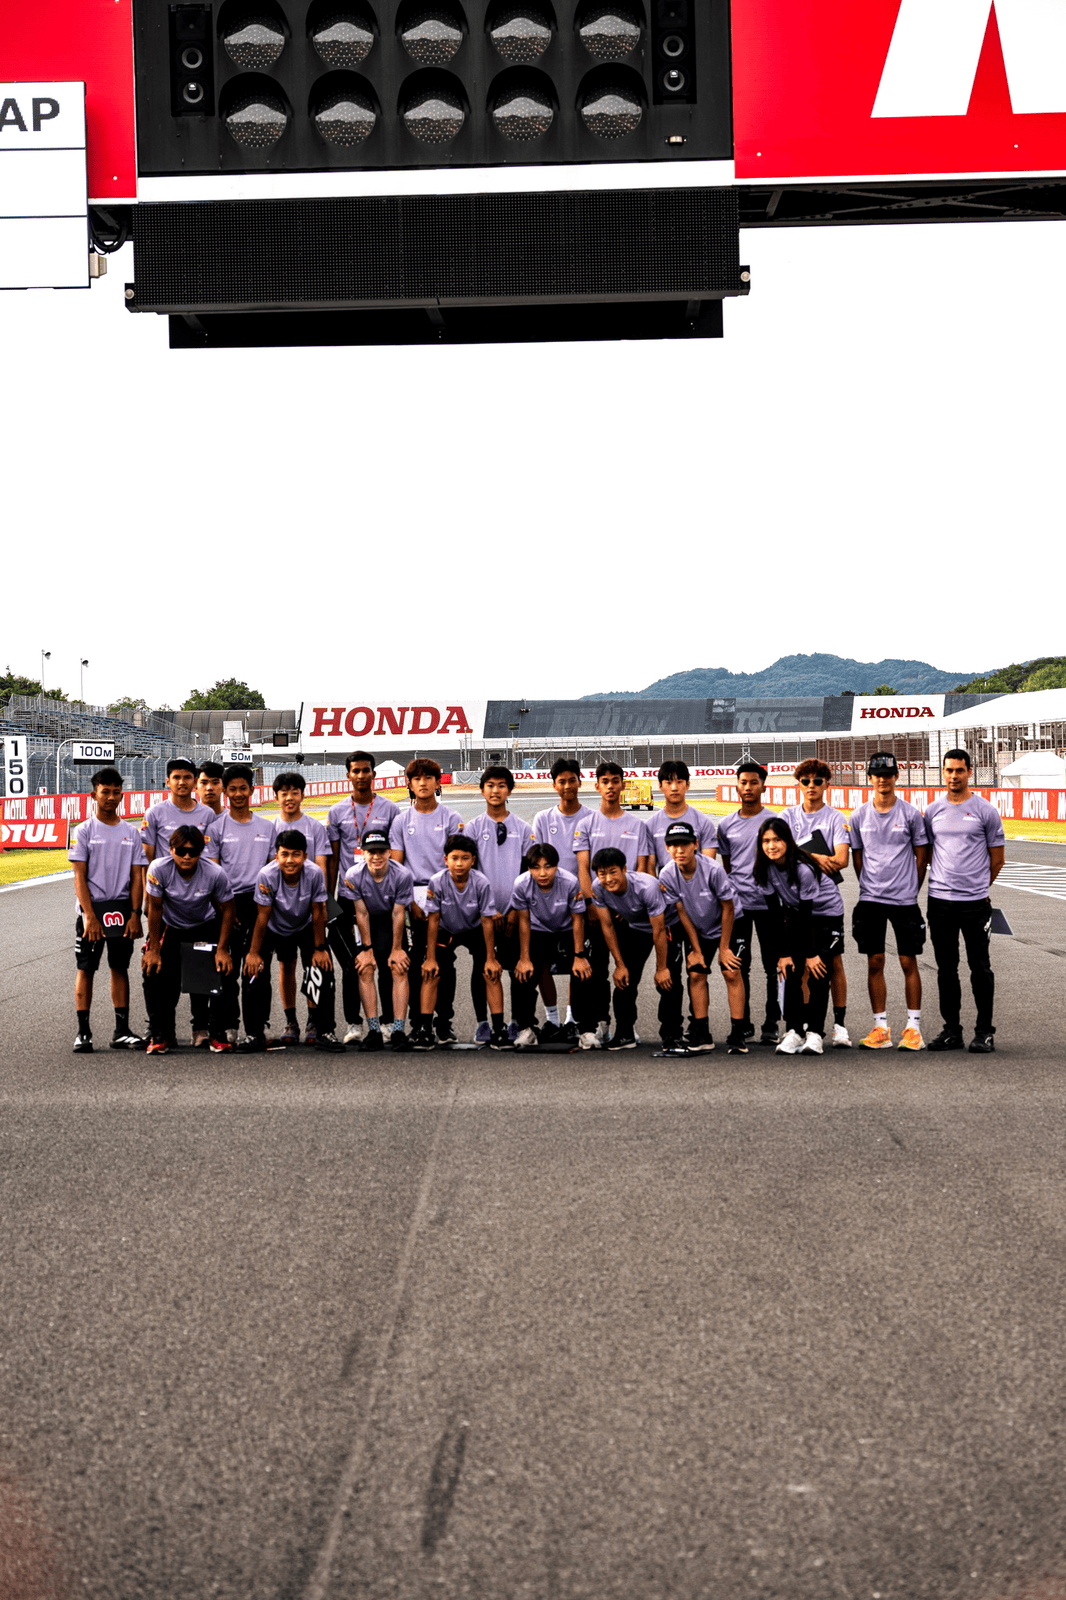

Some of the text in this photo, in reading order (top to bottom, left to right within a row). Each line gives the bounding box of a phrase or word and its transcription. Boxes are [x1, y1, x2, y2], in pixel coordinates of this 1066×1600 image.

[309, 706, 473, 737] HONDA
[860, 707, 935, 719] HONDA
[4, 799, 28, 820] MOTUL
[34, 797, 56, 819] MOTUL
[60, 796, 81, 819] MOTUL
[990, 791, 1015, 817] MOTUL
[1022, 791, 1049, 819] MOTUL
